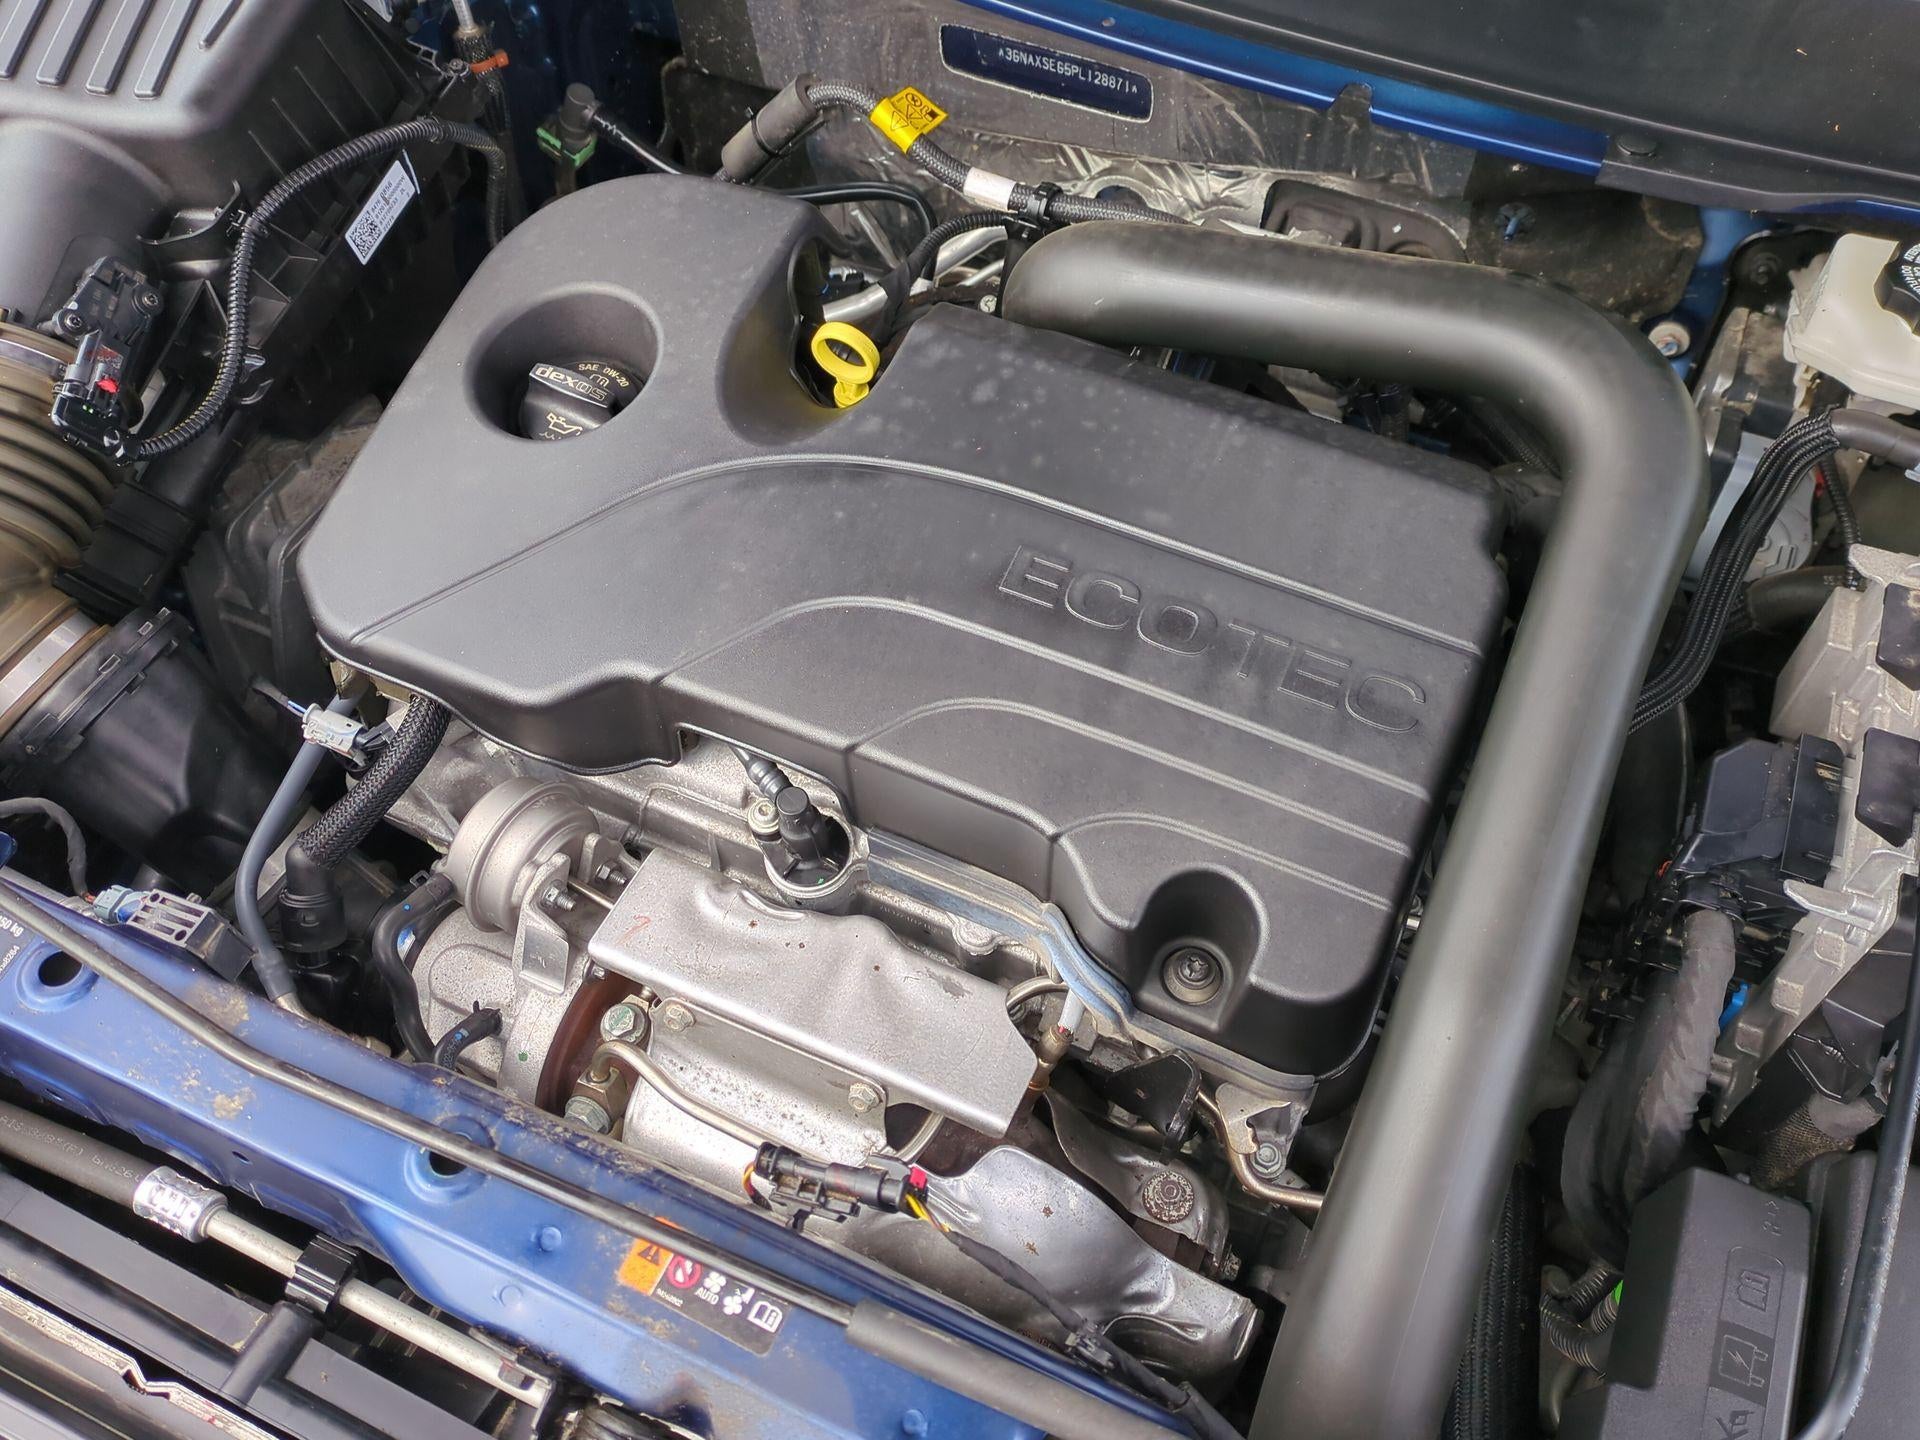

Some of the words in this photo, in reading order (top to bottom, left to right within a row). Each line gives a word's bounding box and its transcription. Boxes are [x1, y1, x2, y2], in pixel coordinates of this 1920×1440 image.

[578, 363, 600, 372] SAE
[535, 366, 608, 401] dexos
[998, 544, 1427, 734] ECOTEC
[10, 922, 24, 937] kg
[694, 1286, 720, 1306] AUTO
